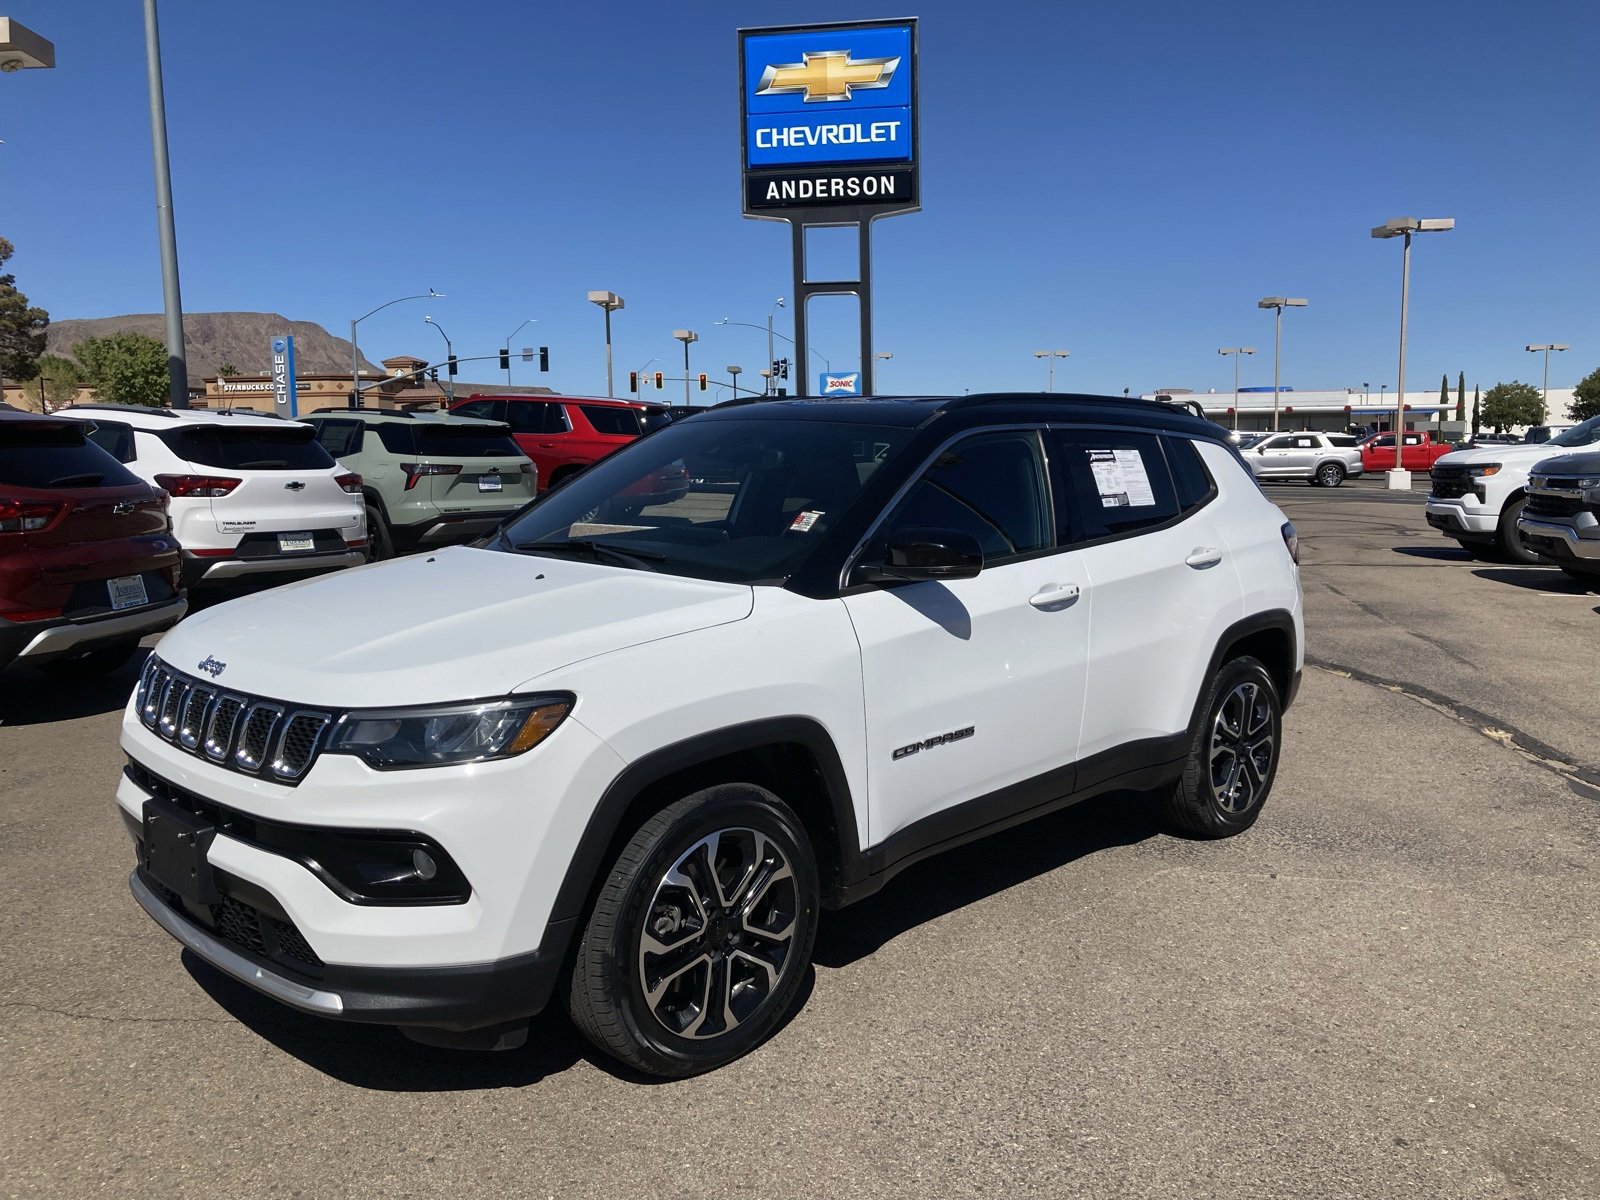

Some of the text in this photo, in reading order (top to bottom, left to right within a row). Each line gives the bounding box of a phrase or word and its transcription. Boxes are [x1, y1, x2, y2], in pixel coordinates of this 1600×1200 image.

[756, 121, 900, 148] CHEVROLET
[766, 176, 895, 200] ANDERSON
[275, 355, 286, 404] CHASE
[198, 655, 226, 678] Jeep
[892, 726, 975, 761] COMPASS
